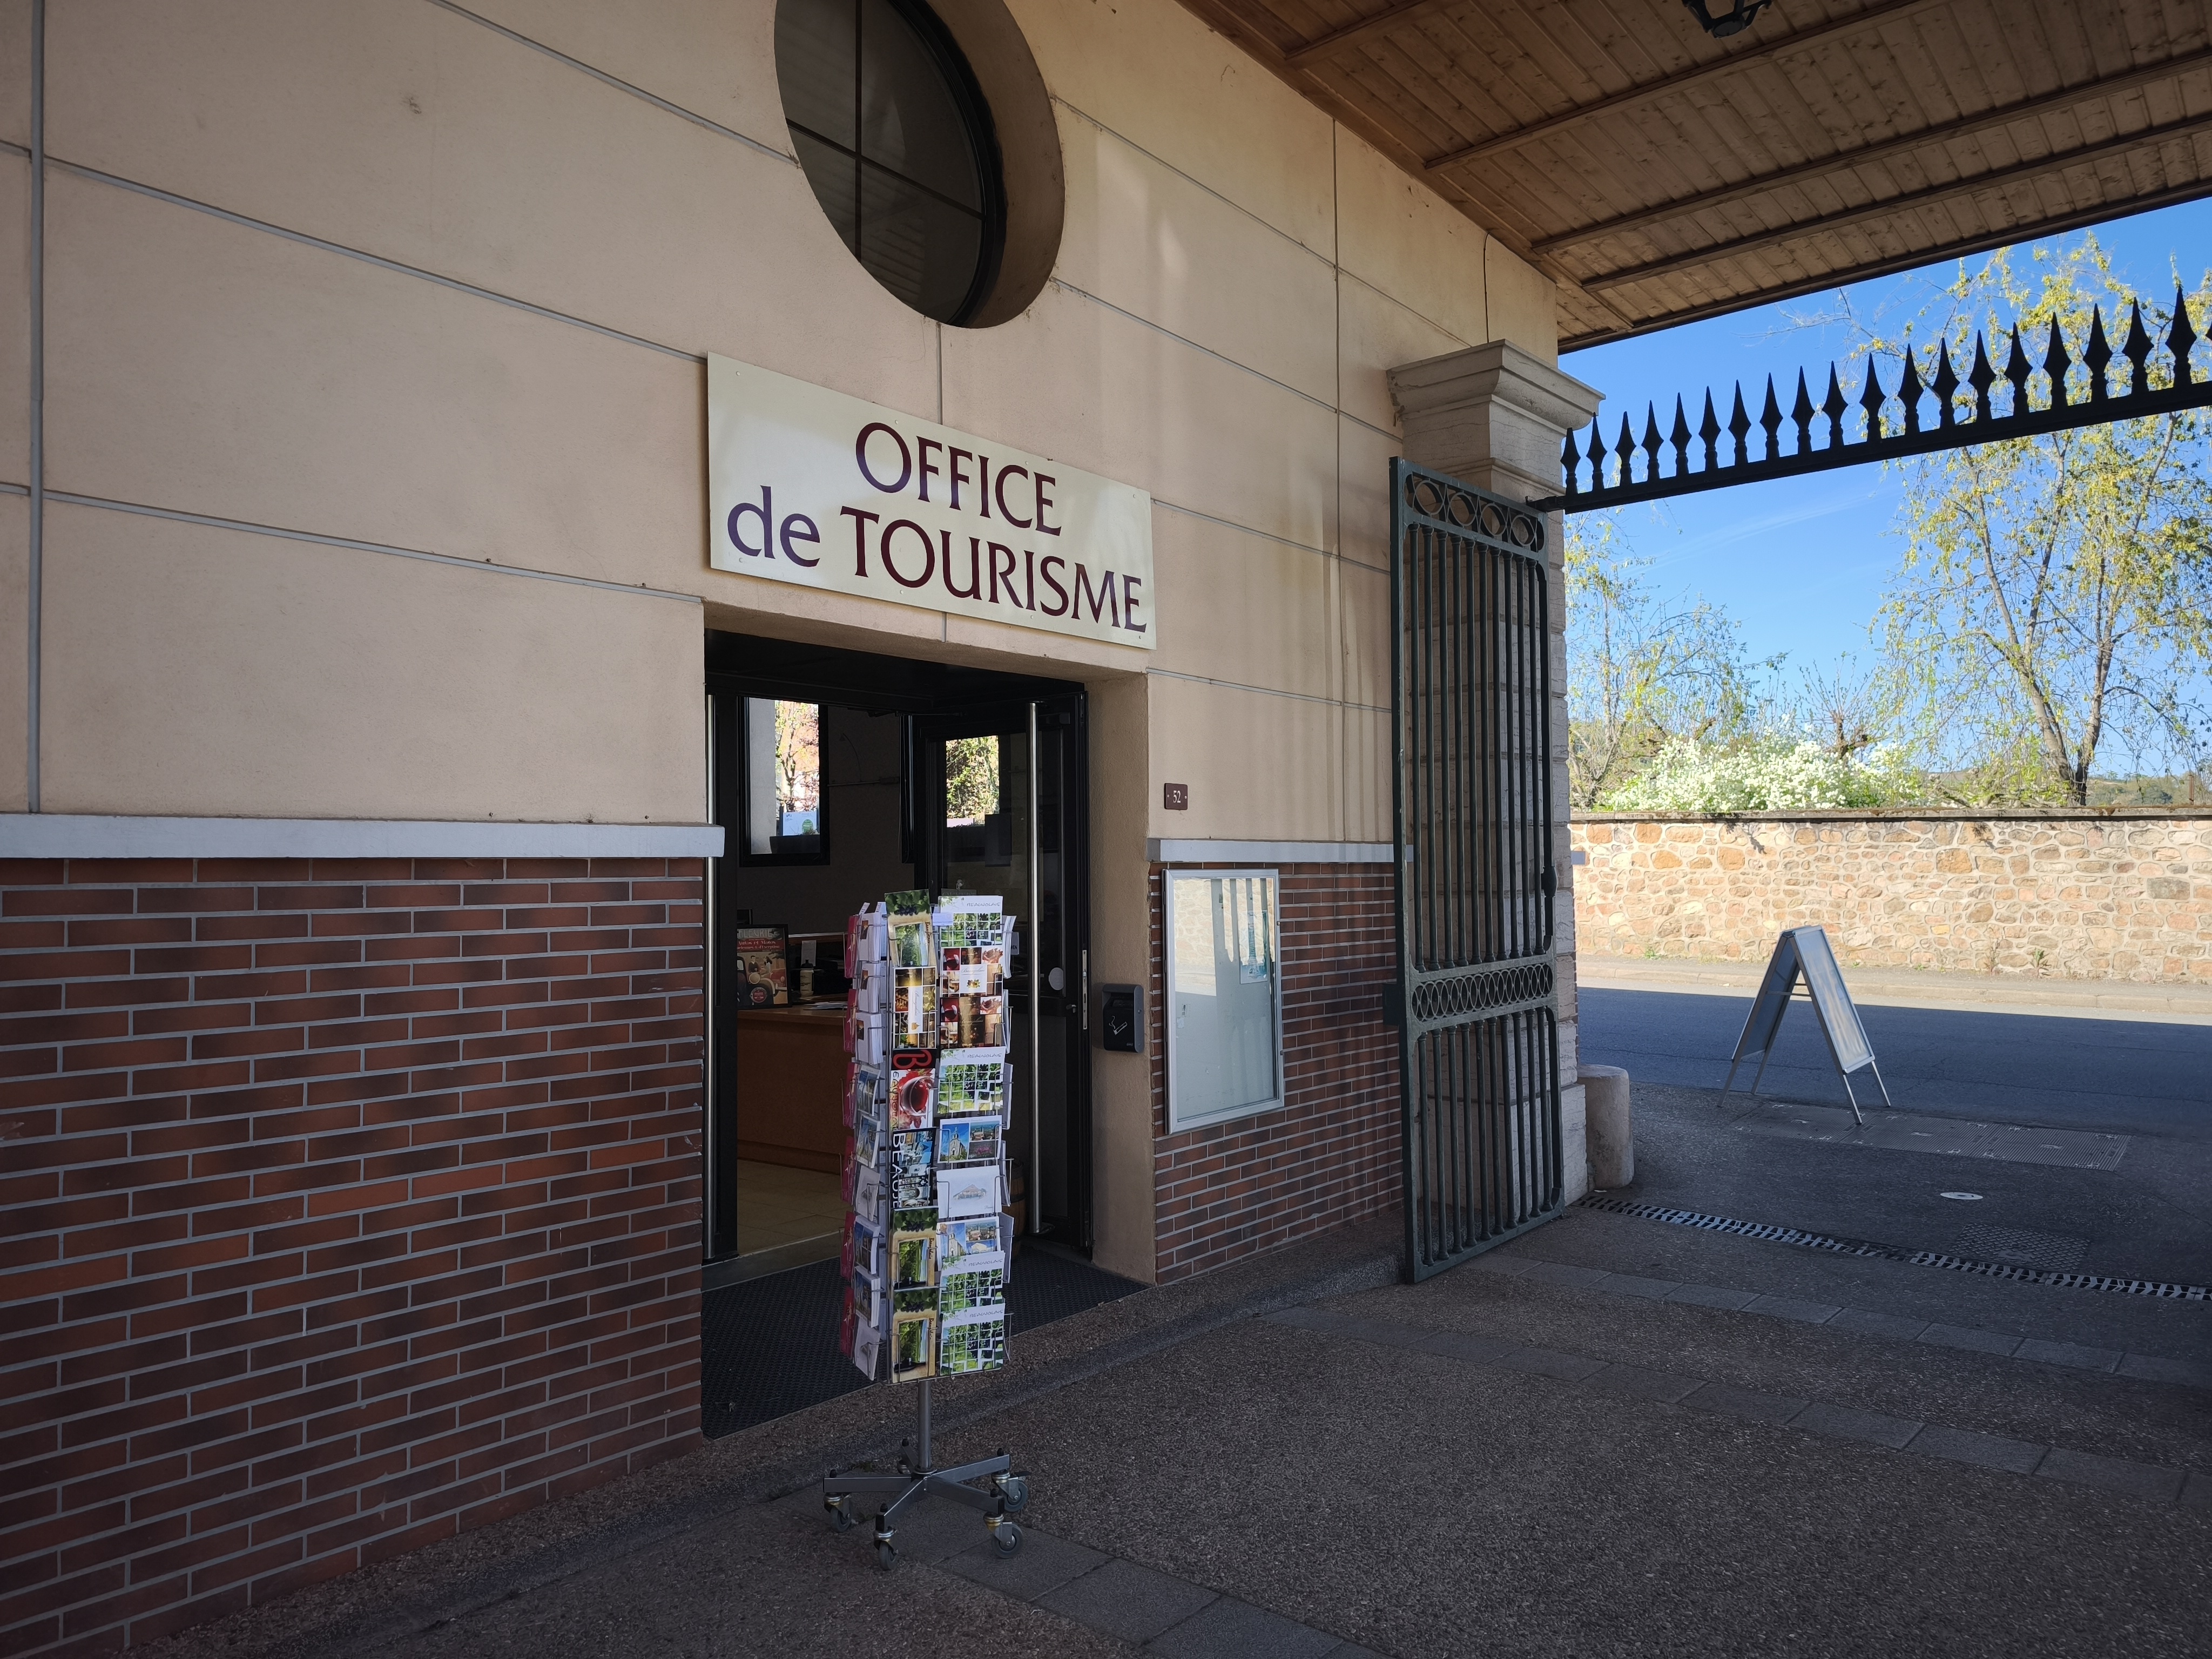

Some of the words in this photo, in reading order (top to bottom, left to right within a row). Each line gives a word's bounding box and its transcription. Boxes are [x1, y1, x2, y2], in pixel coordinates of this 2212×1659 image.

[855, 422, 1062, 536] OFFICE
[727, 485, 820, 567] de
[840, 506, 1147, 633] TOURISME
[1173, 790, 1181, 803] 52
[738, 929, 772, 938] FLEURIE
[968, 1258, 1003, 1266] BEAUJOLAIS
